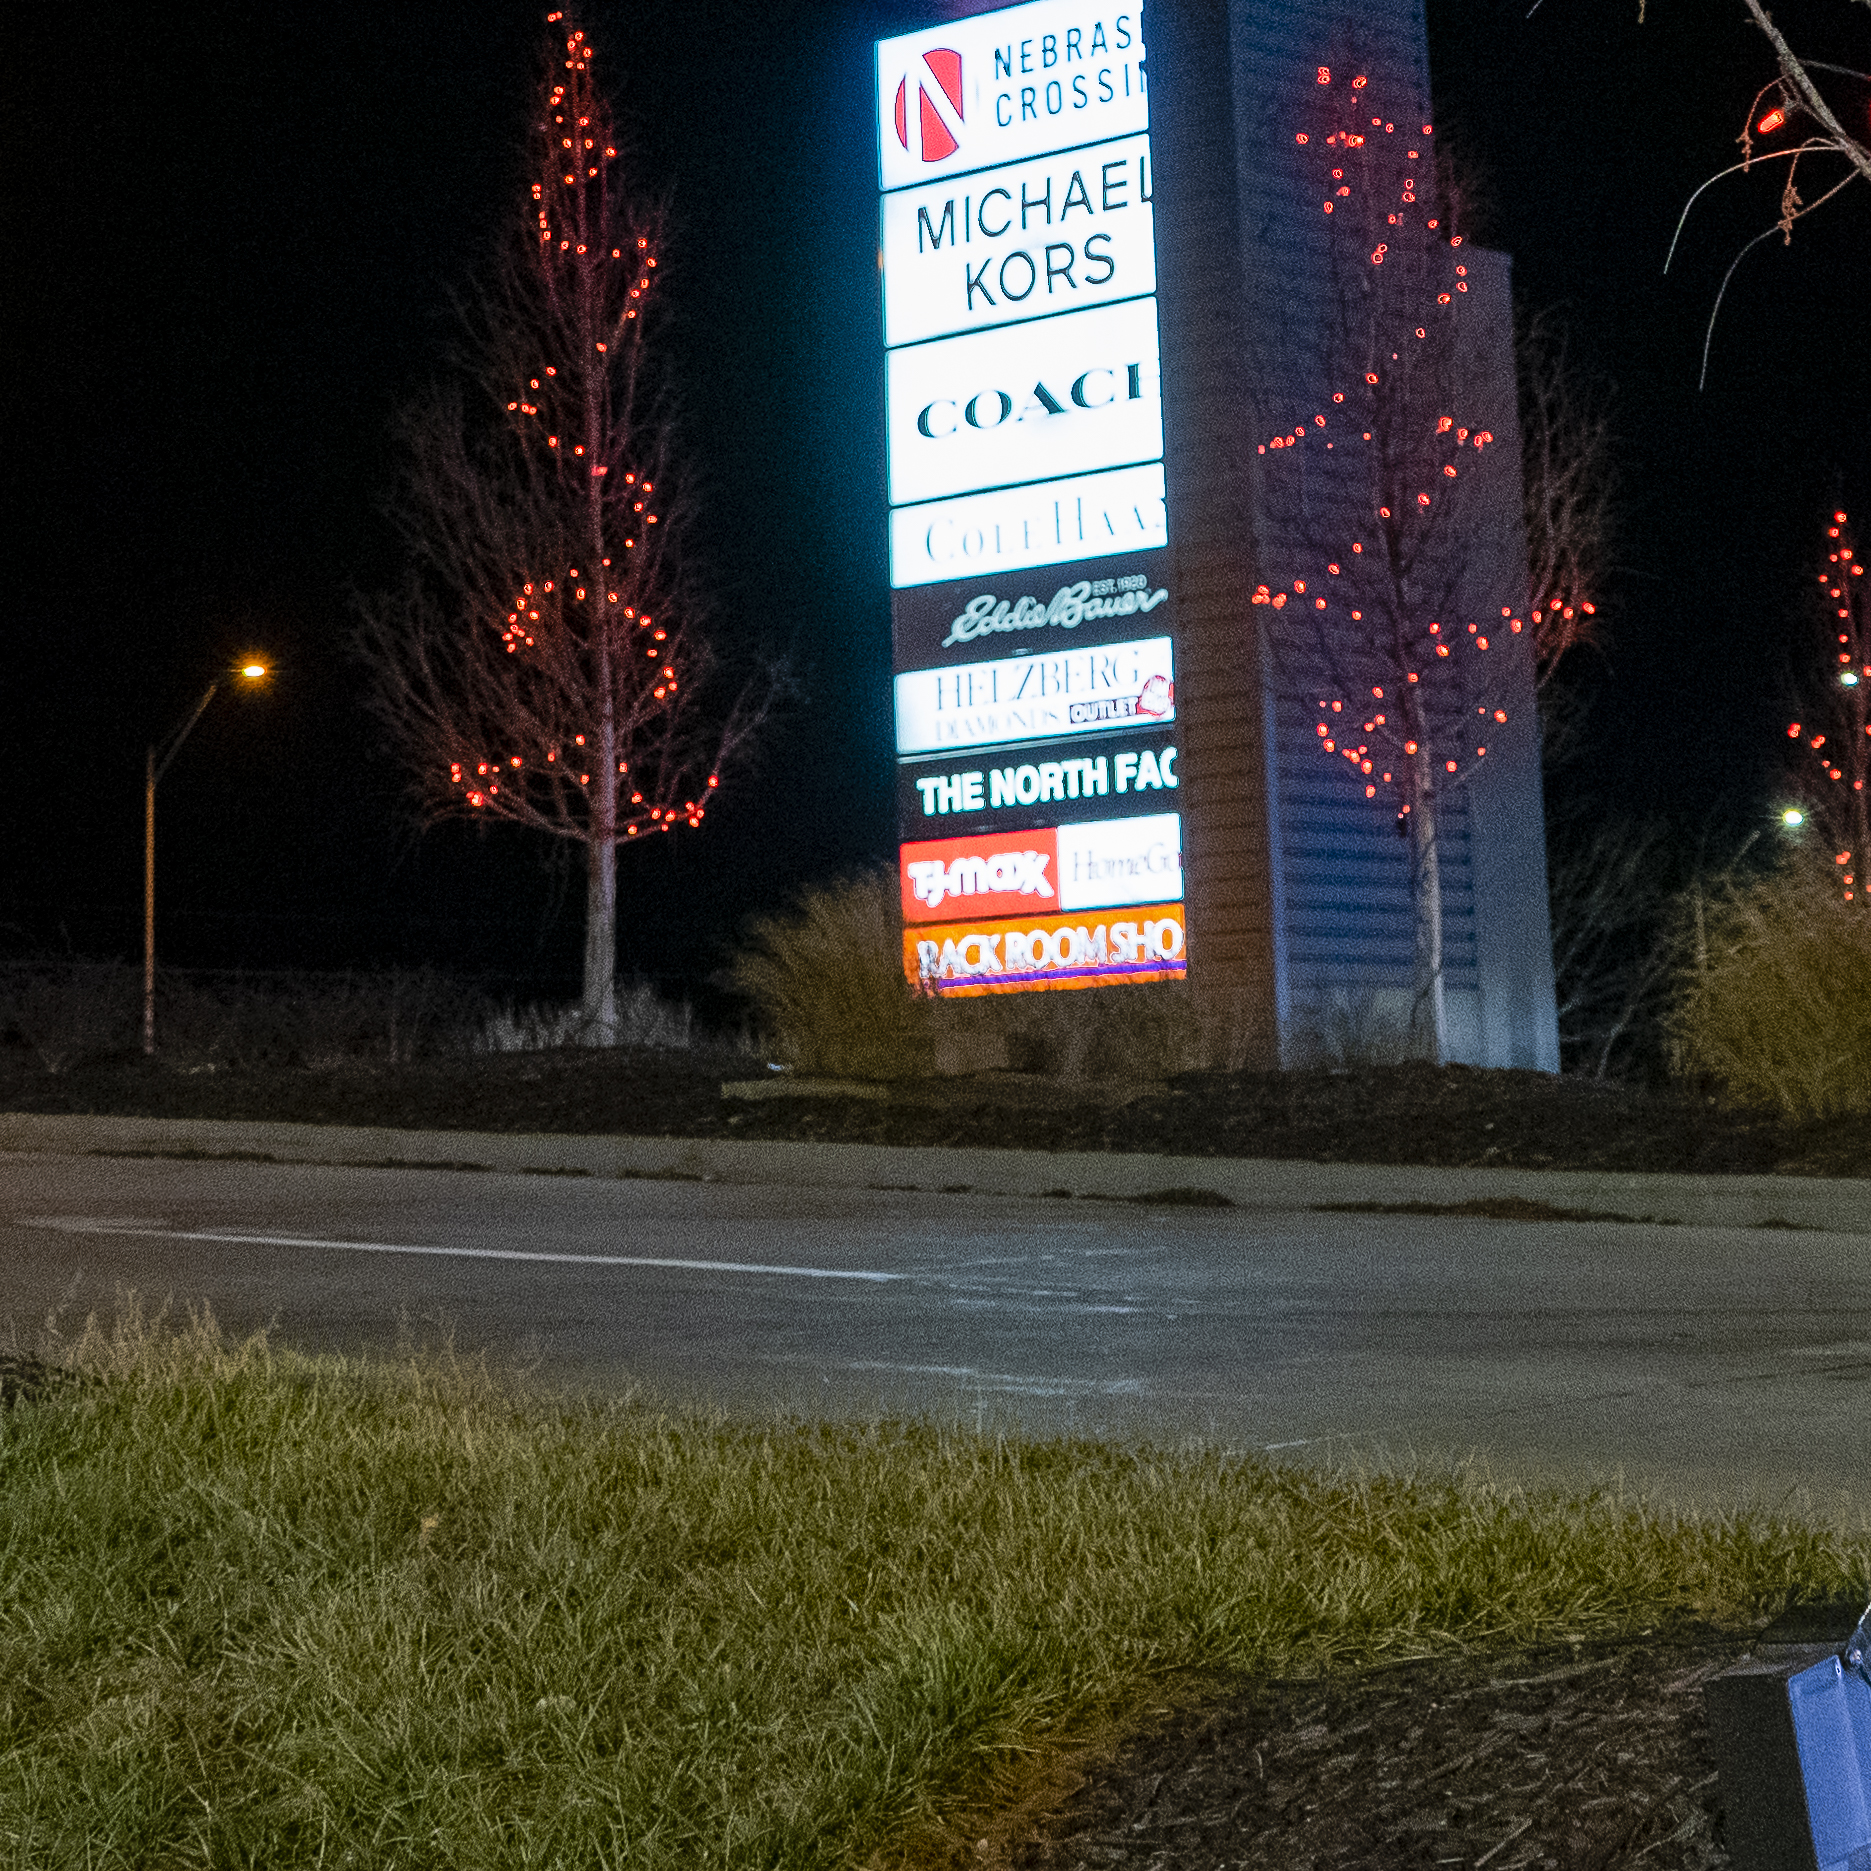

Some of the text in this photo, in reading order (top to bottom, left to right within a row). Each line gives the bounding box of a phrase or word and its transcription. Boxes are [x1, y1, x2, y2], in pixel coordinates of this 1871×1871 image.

[995, 62, 1147, 128] CROSSI
[918, 155, 1152, 255] MICHAEL
[966, 232, 1116, 312] KORS
[1052, 495, 1166, 546] HAA
[940, 580, 1170, 649] Eddie Bauer
[936, 648, 1141, 712] HELZBERG
[1071, 696, 1138, 724] OUTLET
[916, 771, 986, 816] THE
[988, 755, 1110, 809] NORTH
[1005, 925, 1107, 971] ROOM
